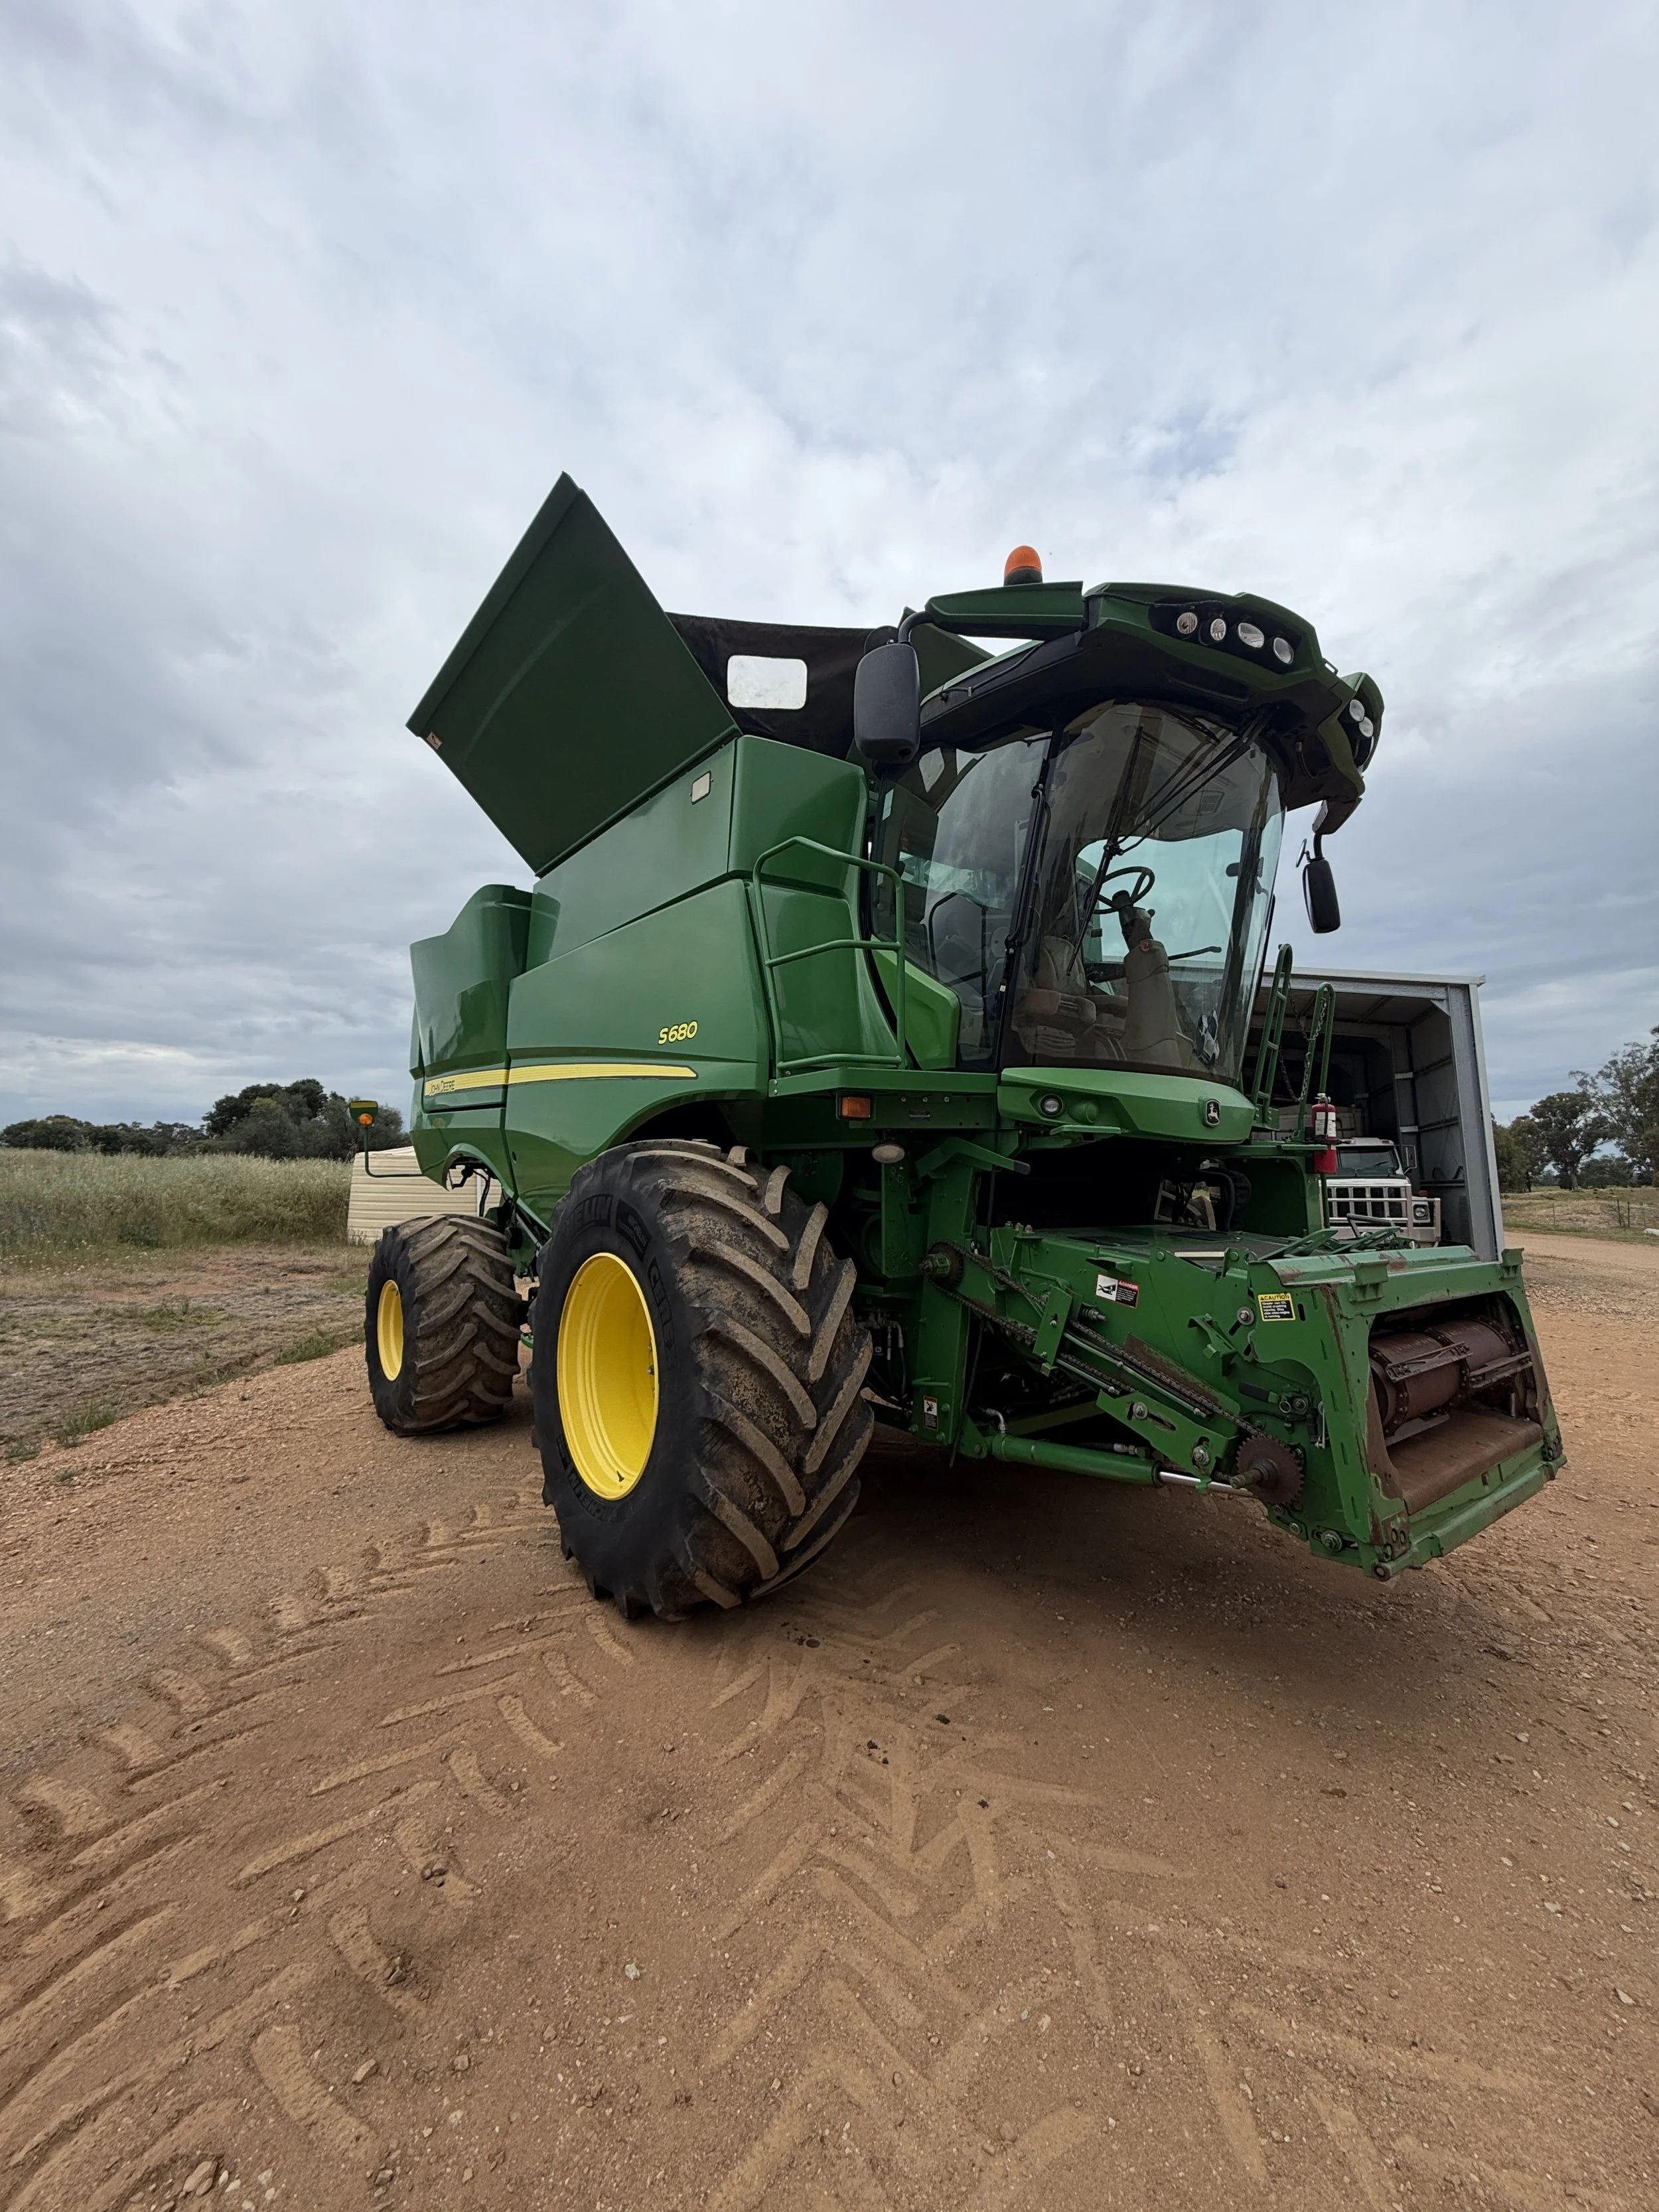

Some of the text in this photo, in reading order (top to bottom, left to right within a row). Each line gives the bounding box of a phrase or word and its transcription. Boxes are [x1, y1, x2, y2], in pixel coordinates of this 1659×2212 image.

[658, 1019, 698, 1045] S680
[429, 1080, 455, 1094] JOHN DEERE
